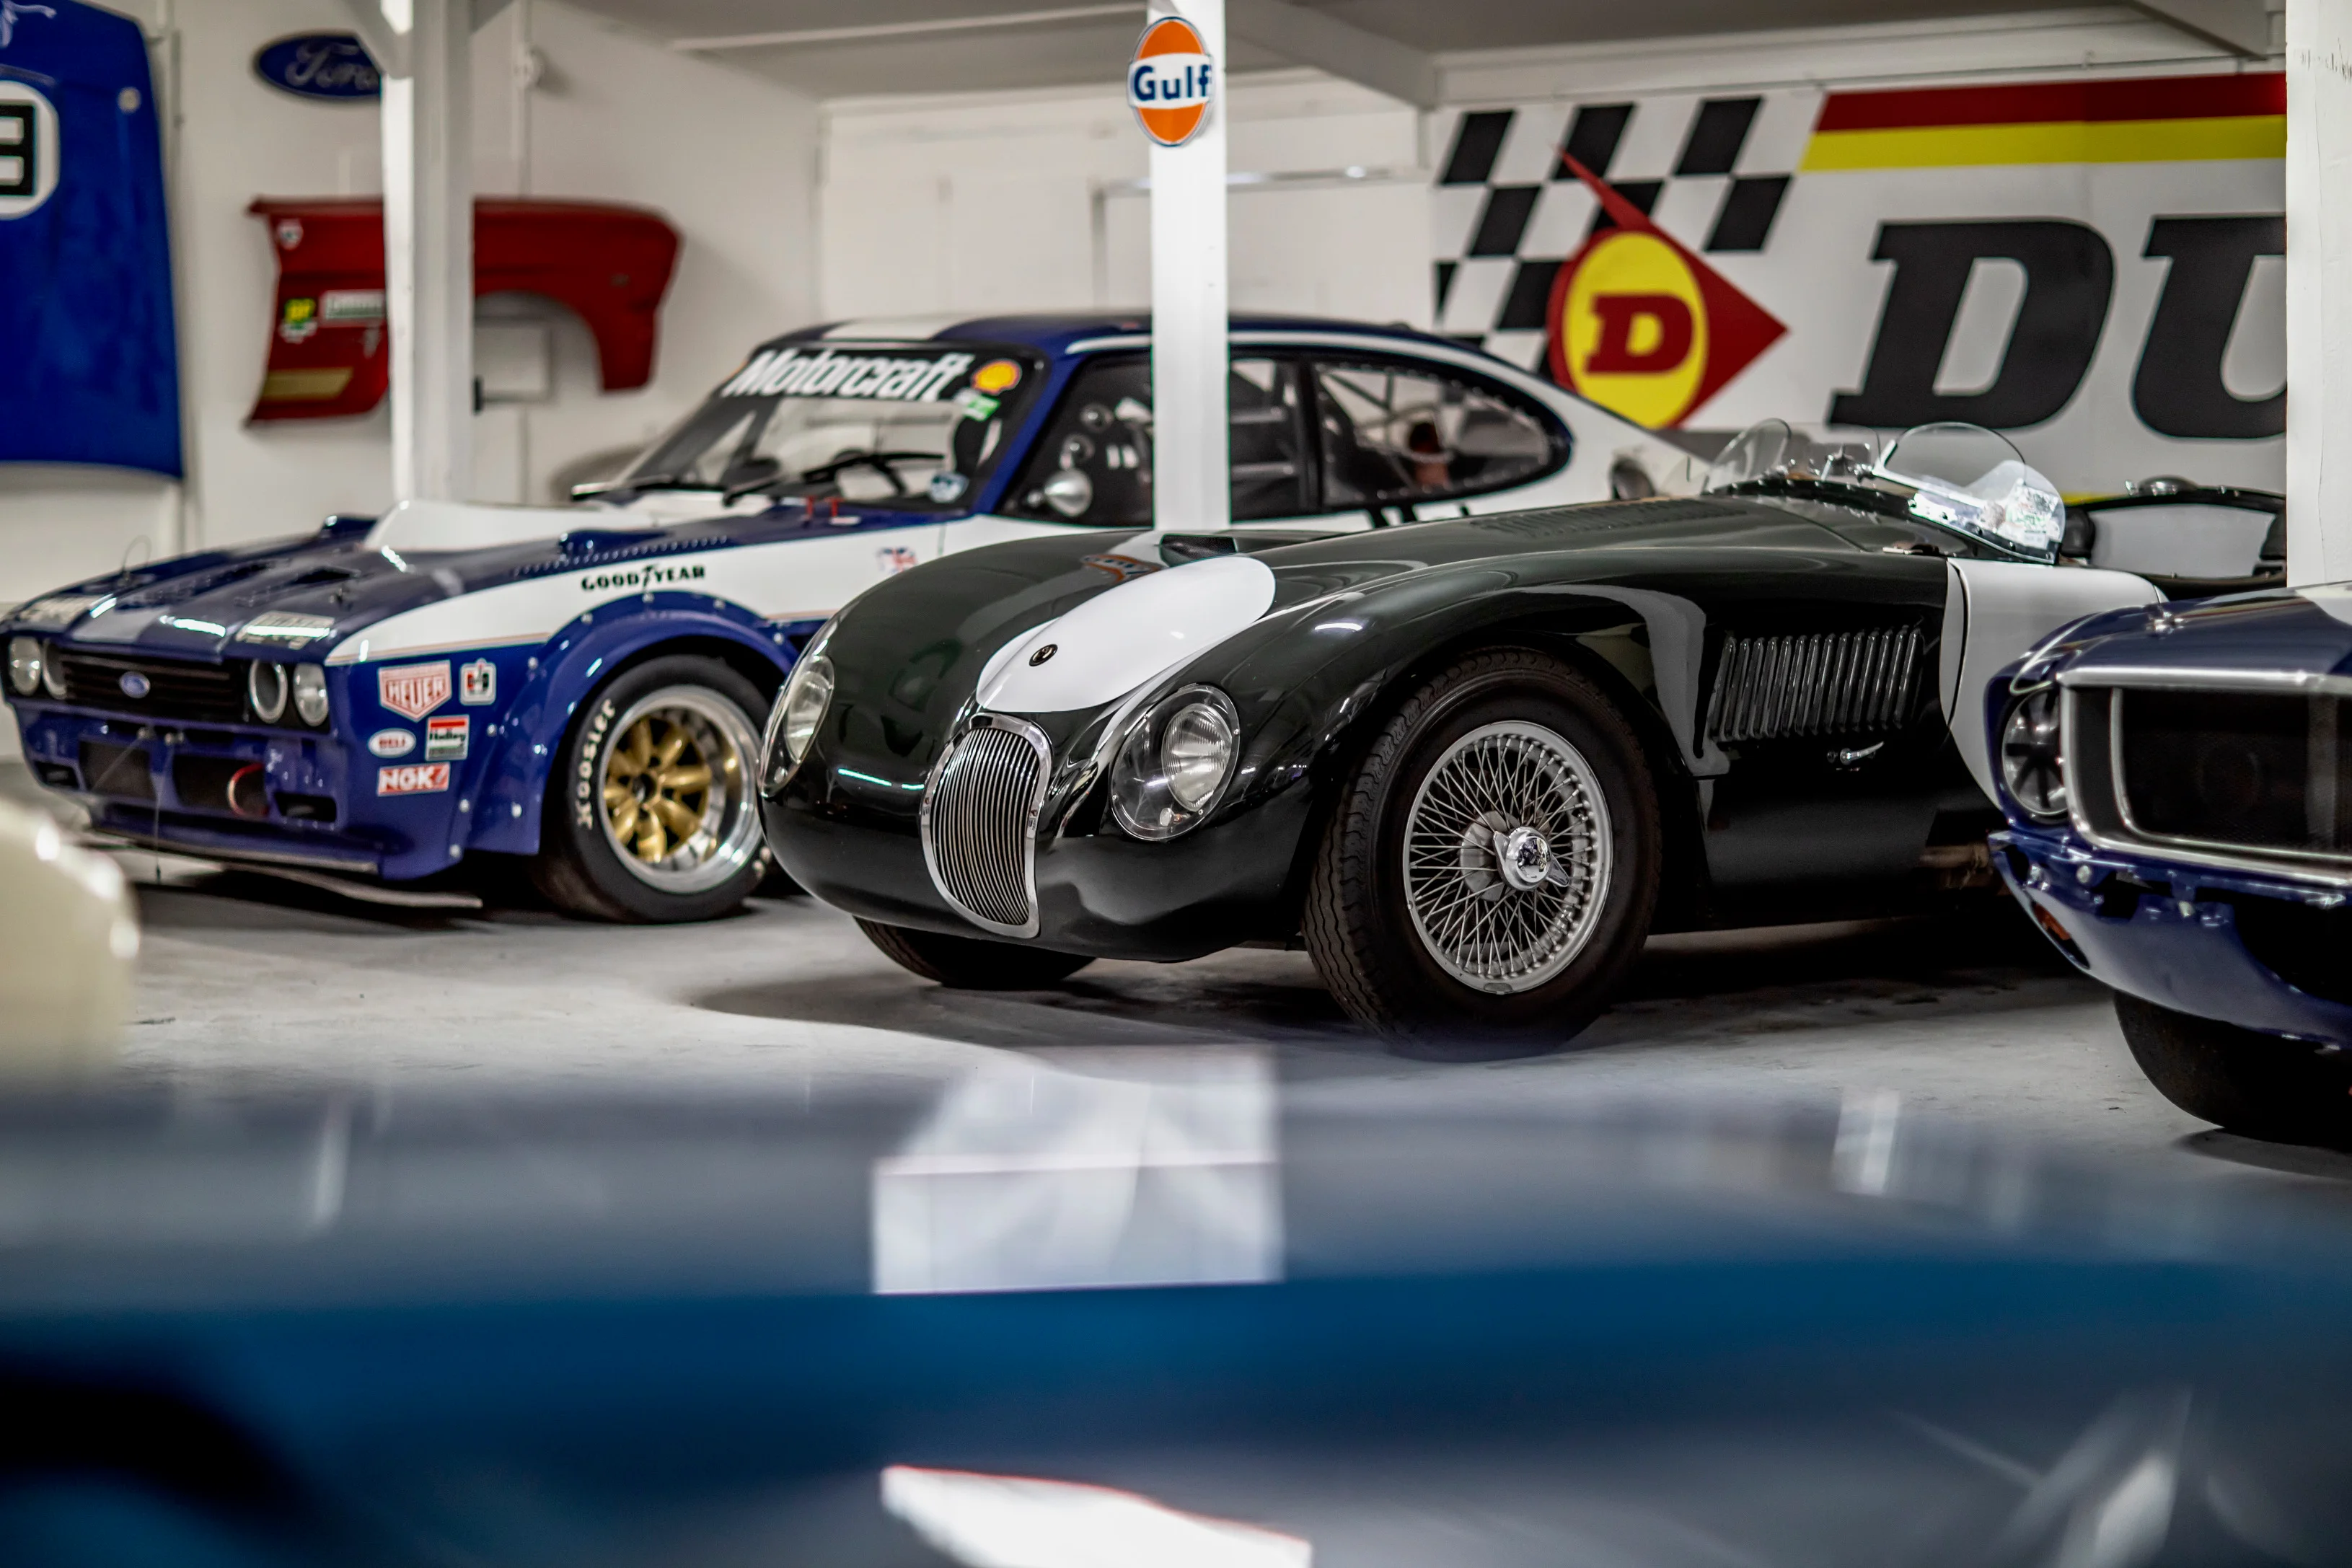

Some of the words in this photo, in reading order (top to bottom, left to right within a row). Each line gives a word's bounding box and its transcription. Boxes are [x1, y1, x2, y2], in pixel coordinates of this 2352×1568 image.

[1134, 64, 1210, 101] Gulf
[1584, 292, 1693, 376] D
[721, 348, 976, 403] Motorcraft
[384, 676, 446, 713] HEUER
